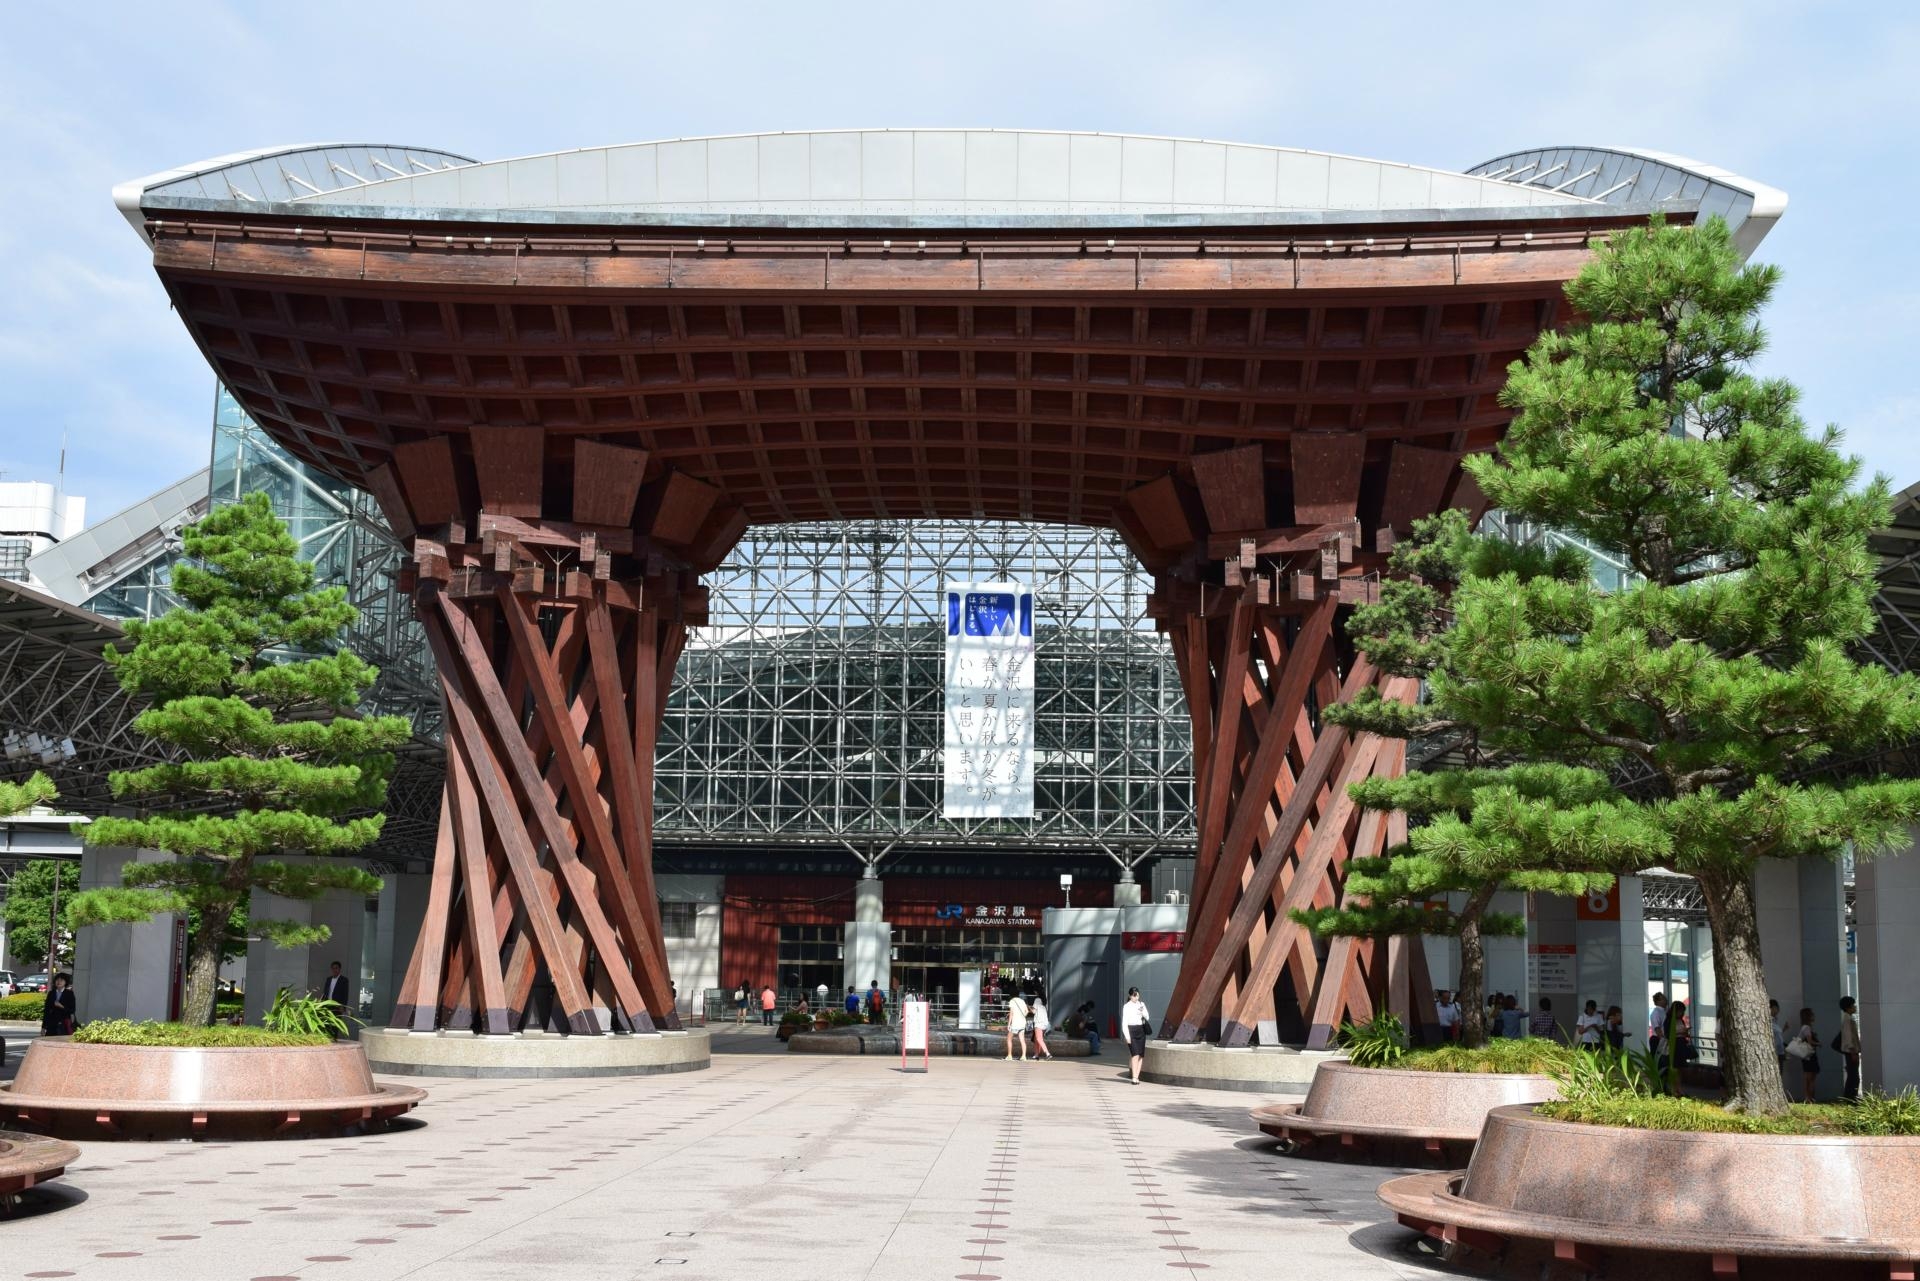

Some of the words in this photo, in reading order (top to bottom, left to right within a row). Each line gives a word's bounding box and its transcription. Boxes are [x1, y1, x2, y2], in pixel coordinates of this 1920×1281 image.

[969, 596, 978, 632] はじまる。
[979, 596, 988, 618] 金沢、
[990, 596, 999, 621] 新しい
[959, 658, 973, 793] いいと思います。
[982, 656, 998, 801] 春か夏か秋か冬が
[1006, 656, 1021, 793] 金沢に来るなら、
[937, 904, 963, 919] JR
[975, 905, 1026, 917] 金沢駅
